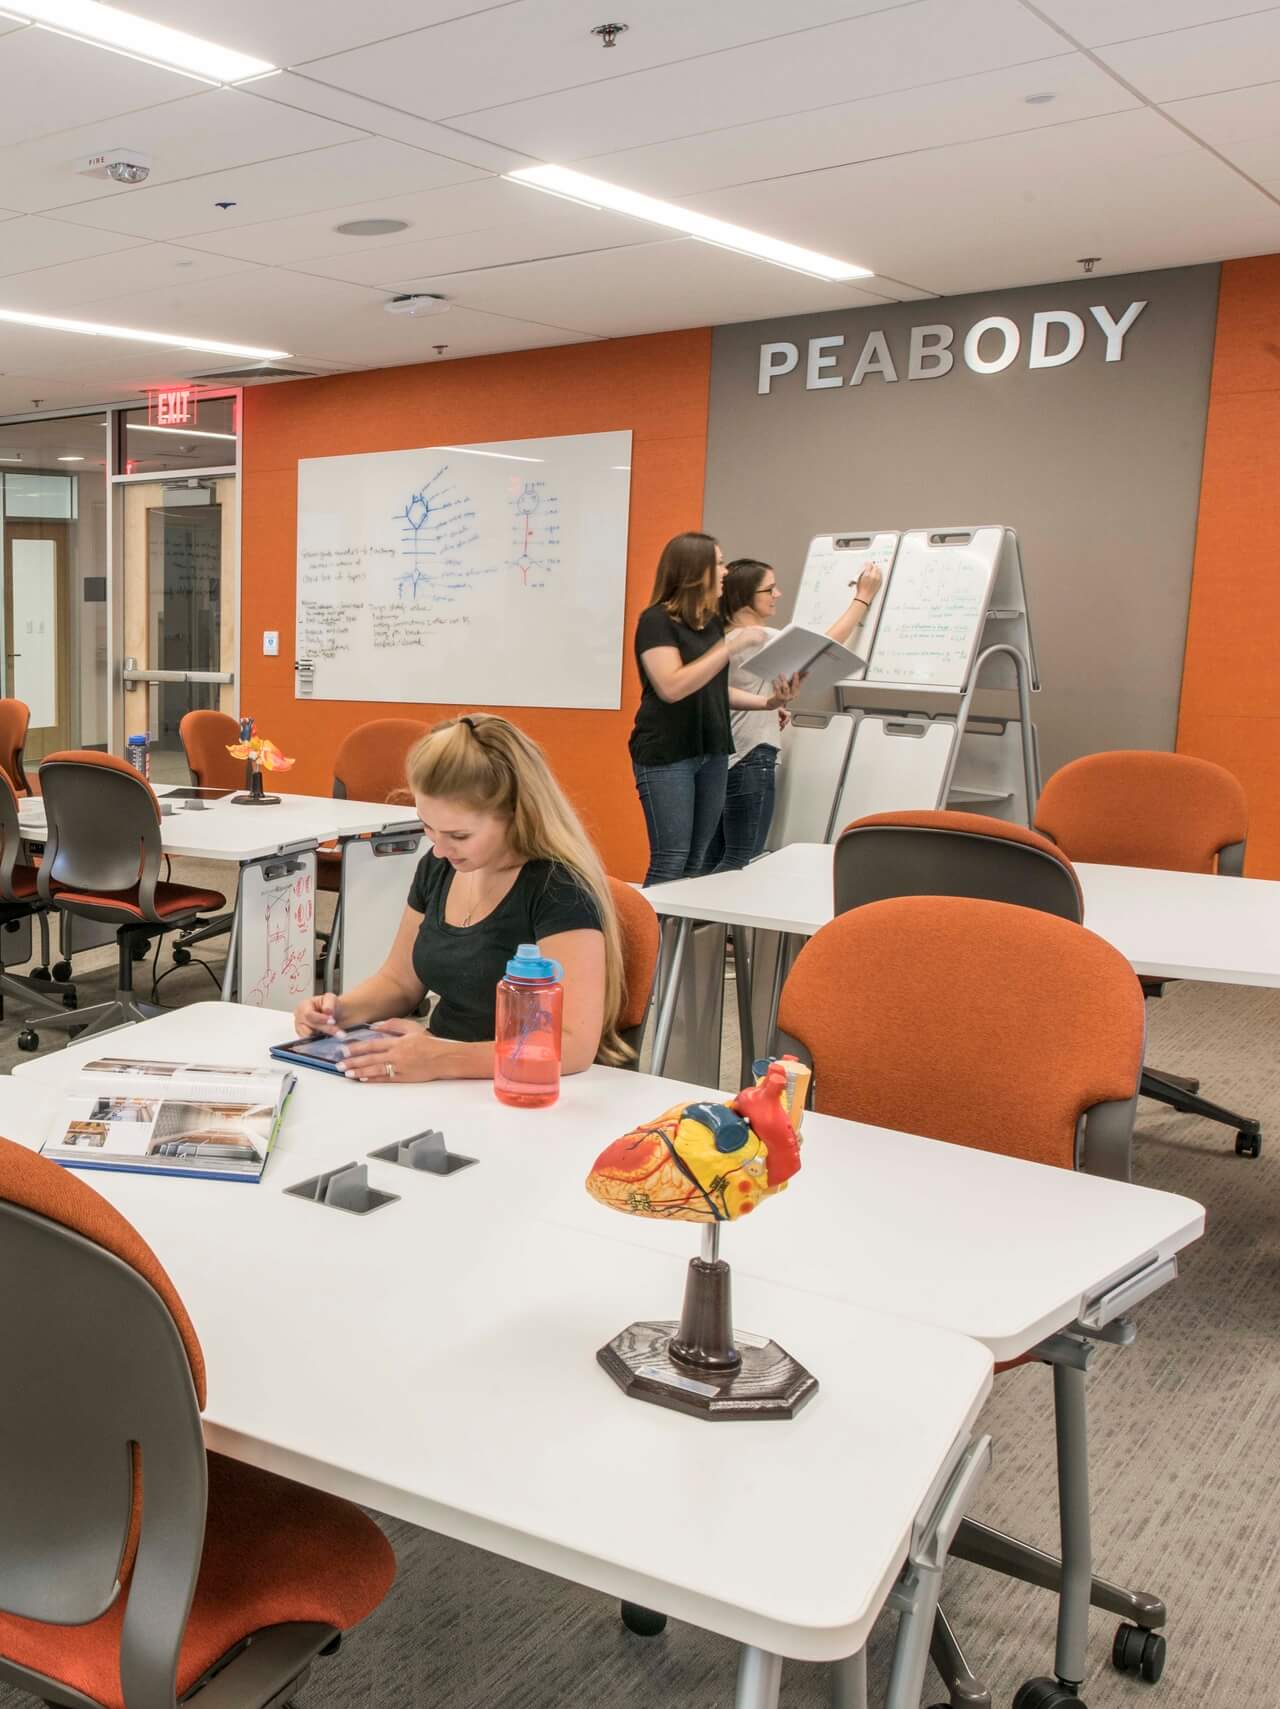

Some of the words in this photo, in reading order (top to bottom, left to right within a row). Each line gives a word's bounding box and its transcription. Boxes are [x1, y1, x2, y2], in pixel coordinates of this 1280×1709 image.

[89, 156, 104, 166] FIRE
[757, 300, 1148, 395] PEABODY
[158, 391, 190, 424] EXIT
